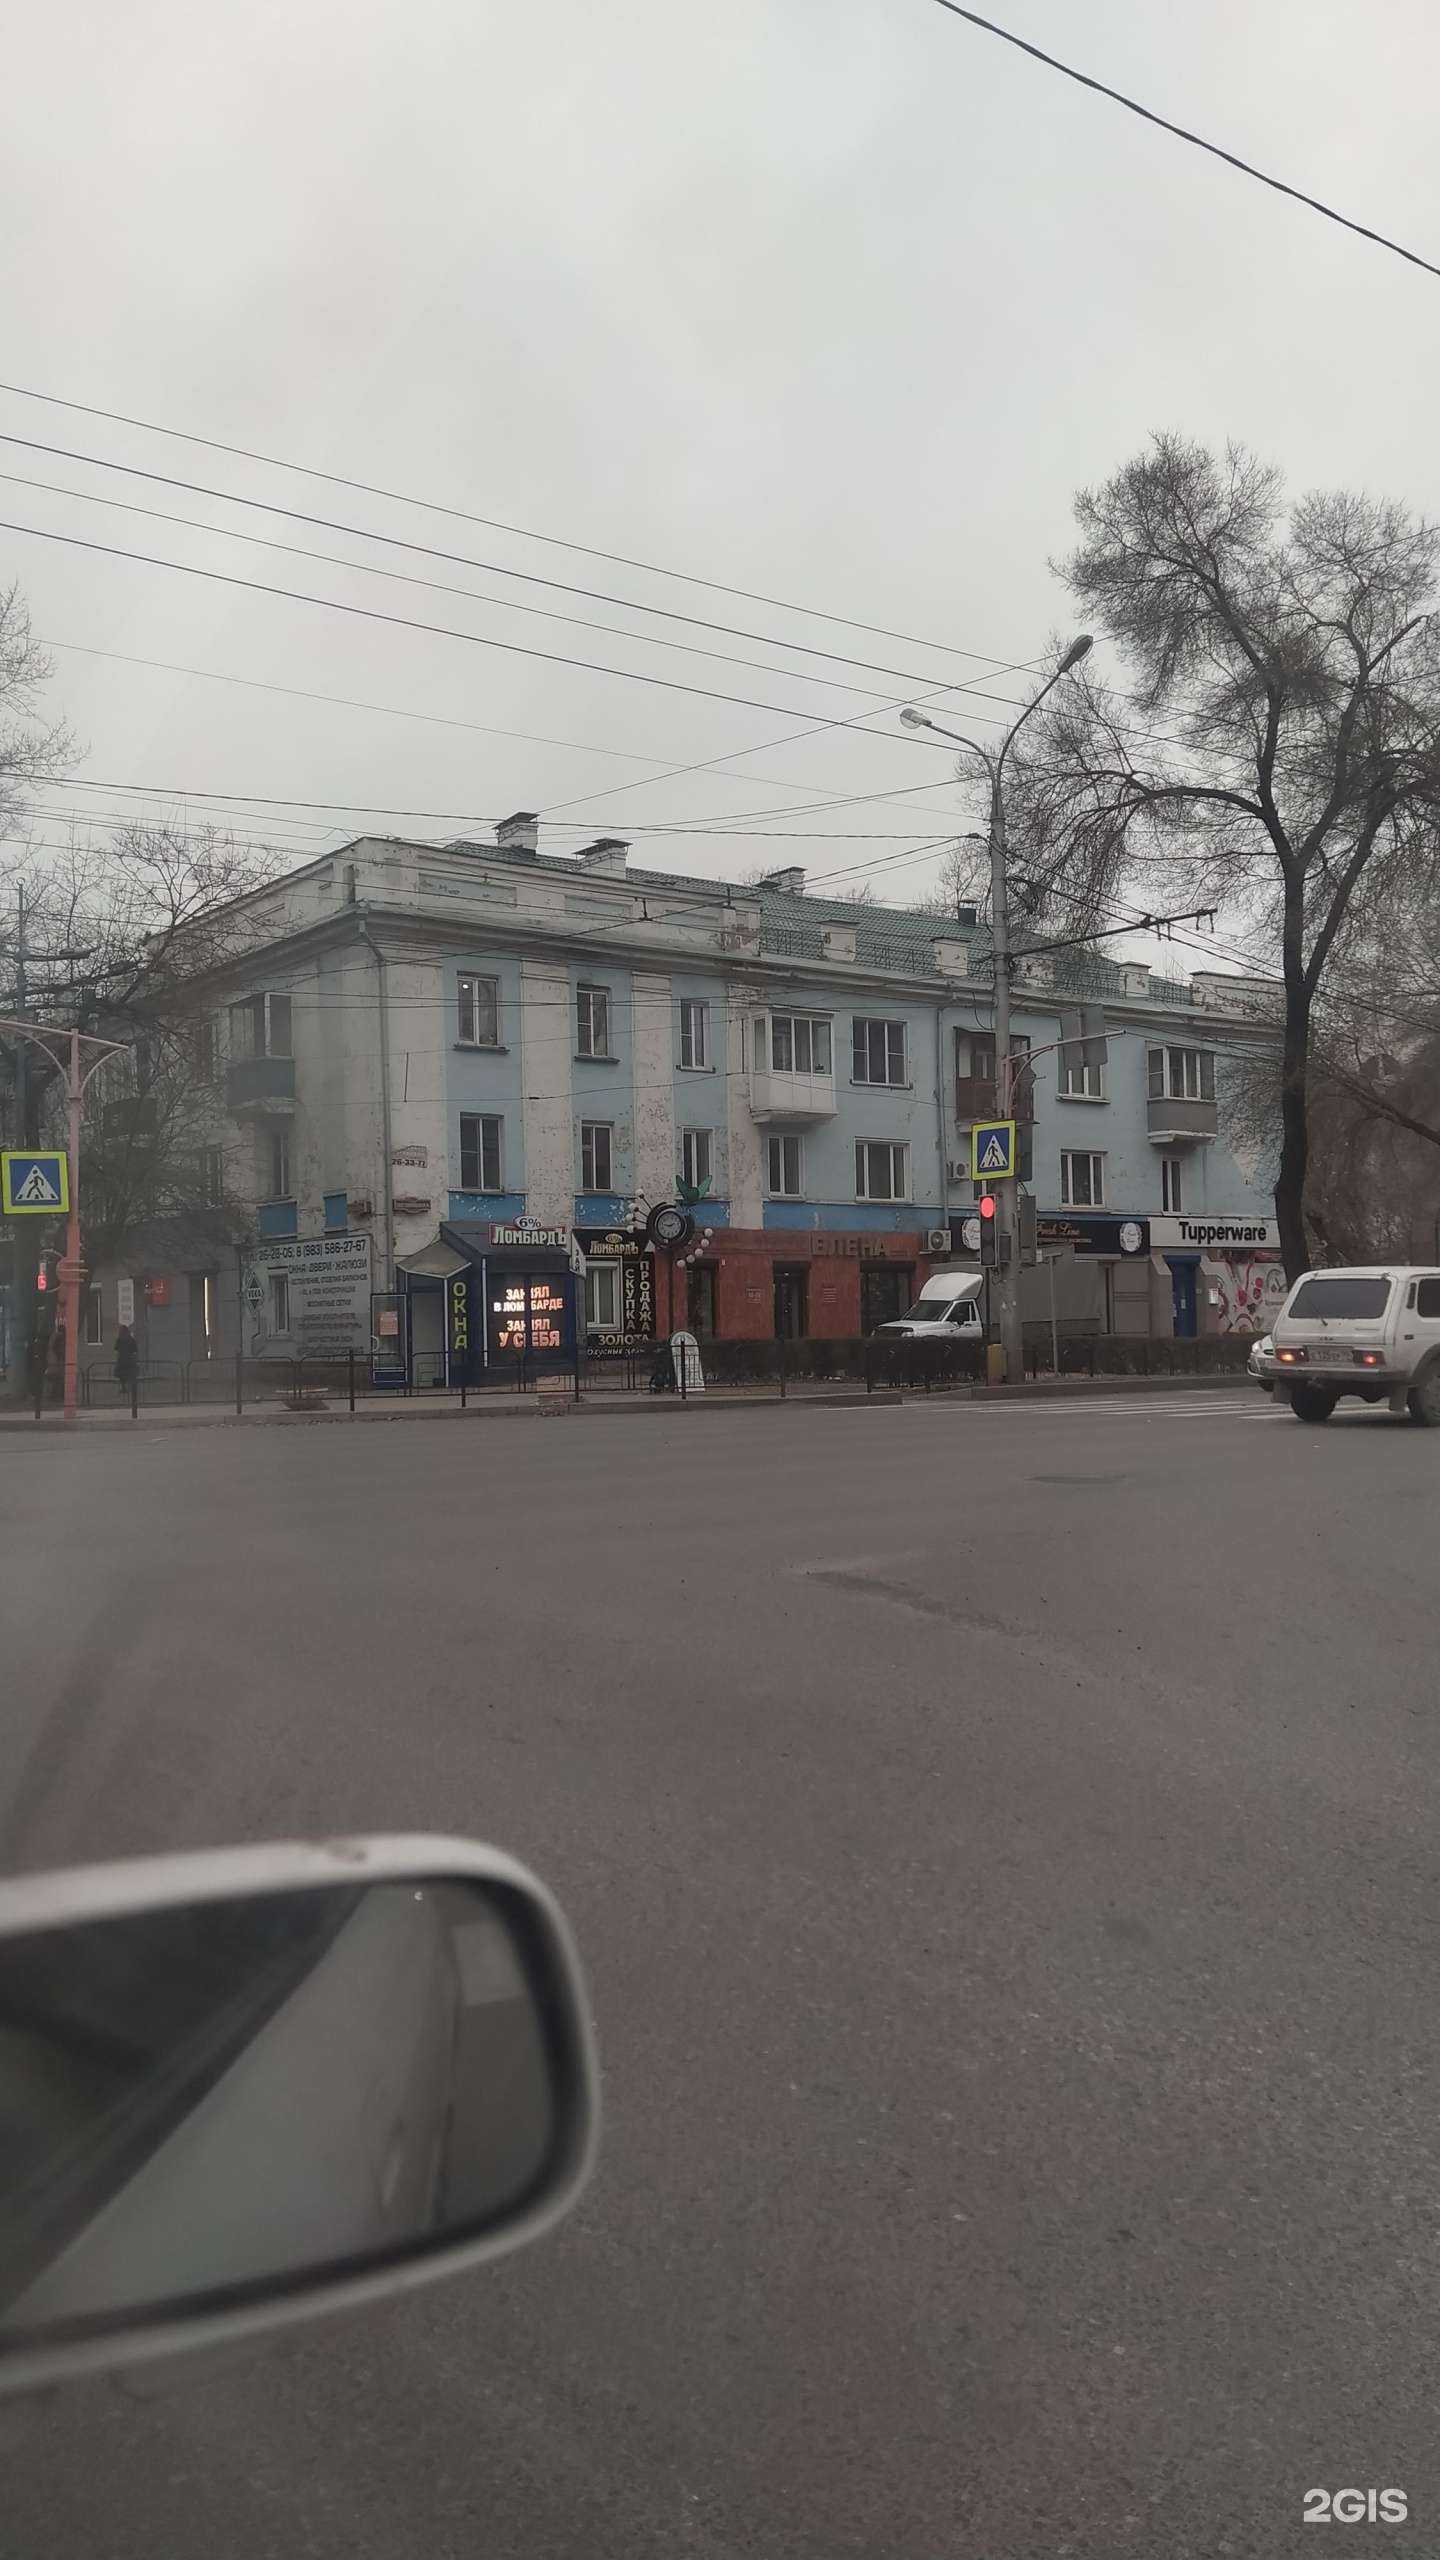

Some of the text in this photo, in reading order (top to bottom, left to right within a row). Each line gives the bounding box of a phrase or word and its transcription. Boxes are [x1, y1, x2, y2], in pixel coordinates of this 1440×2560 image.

[519, 1217, 542, 1228] 6%
[1179, 1221, 1267, 1245] Tupperware
[296, 1246, 302, 1258] 8
[493, 1298, 564, 1313] В ЛОМБАРДЕ
[624, 1268, 636, 1331] СКУПКА
[640, 1260, 652, 1332] ПРОДАЖА
[453, 1281, 468, 1350] ОКНА
[498, 1331, 561, 1348] У СЕБЯ
